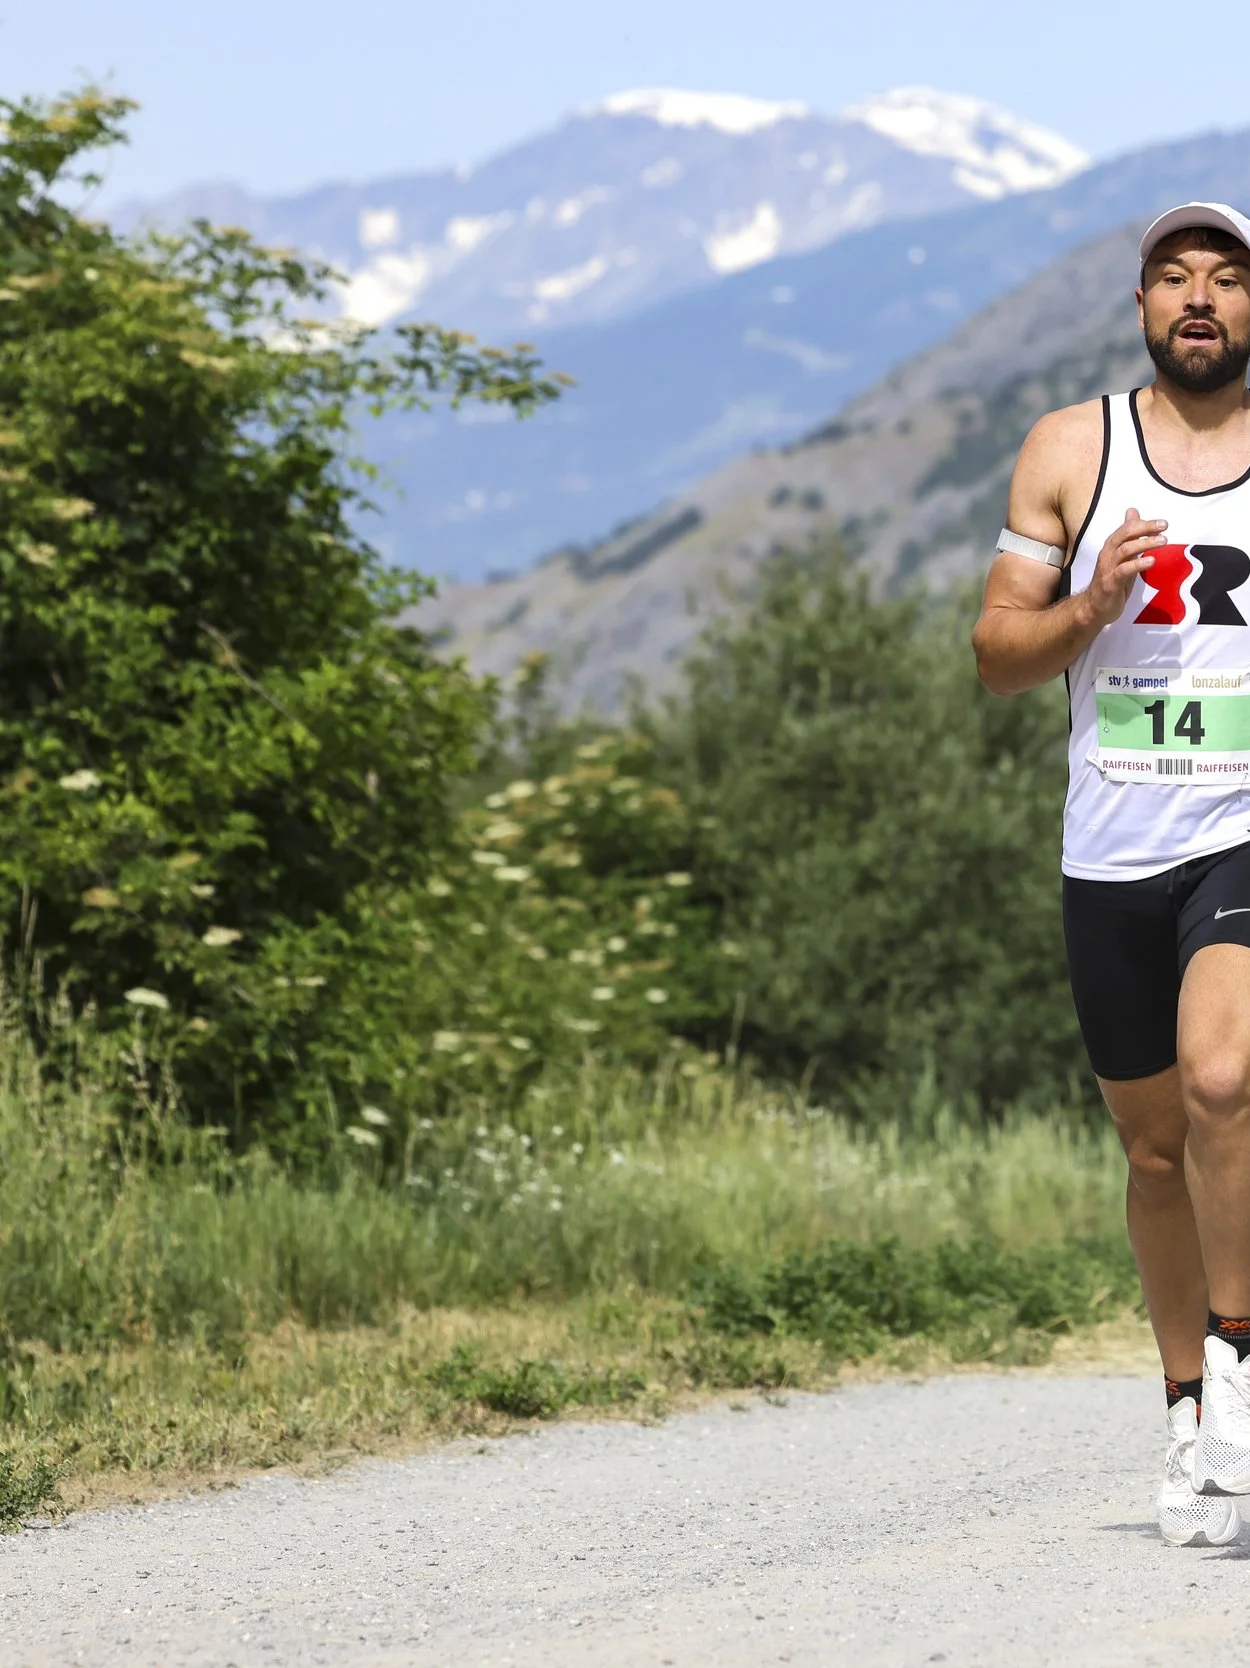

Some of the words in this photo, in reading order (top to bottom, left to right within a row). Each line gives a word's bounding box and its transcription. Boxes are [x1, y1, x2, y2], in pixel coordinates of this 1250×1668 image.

[1108, 675, 1121, 686] stv
[1132, 676, 1168, 689] gampel
[1192, 675, 1243, 688] lonzalauf
[1144, 700, 1205, 745] 14
[1102, 760, 1151, 771] RAIFFEISEN
[1196, 762, 1249, 773] RAIFFEISEN
